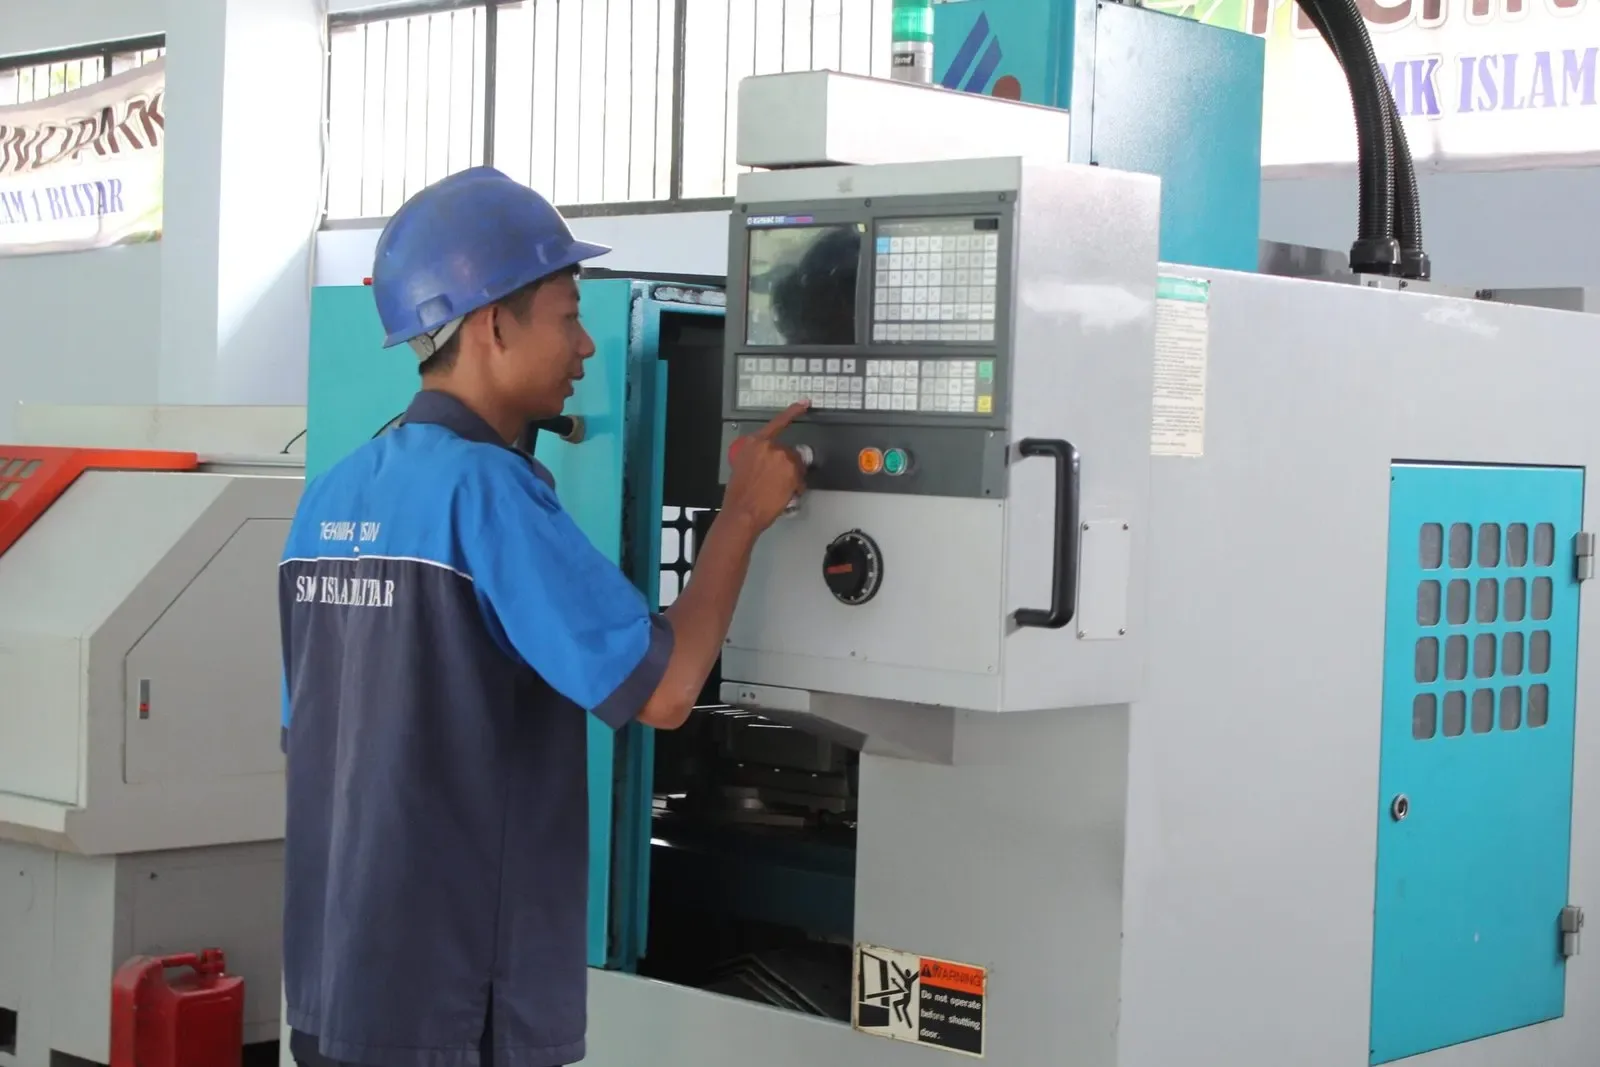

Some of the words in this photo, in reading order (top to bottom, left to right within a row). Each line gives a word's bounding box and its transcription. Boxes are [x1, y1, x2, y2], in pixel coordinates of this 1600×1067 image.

[1457, 47, 1599, 113] ISLAM
[920, 989, 933, 1000] Do
[934, 993, 948, 1004] not
[949, 997, 982, 1010] operate
[920, 1008, 945, 1022] before
[948, 1015, 981, 1031] shutting
